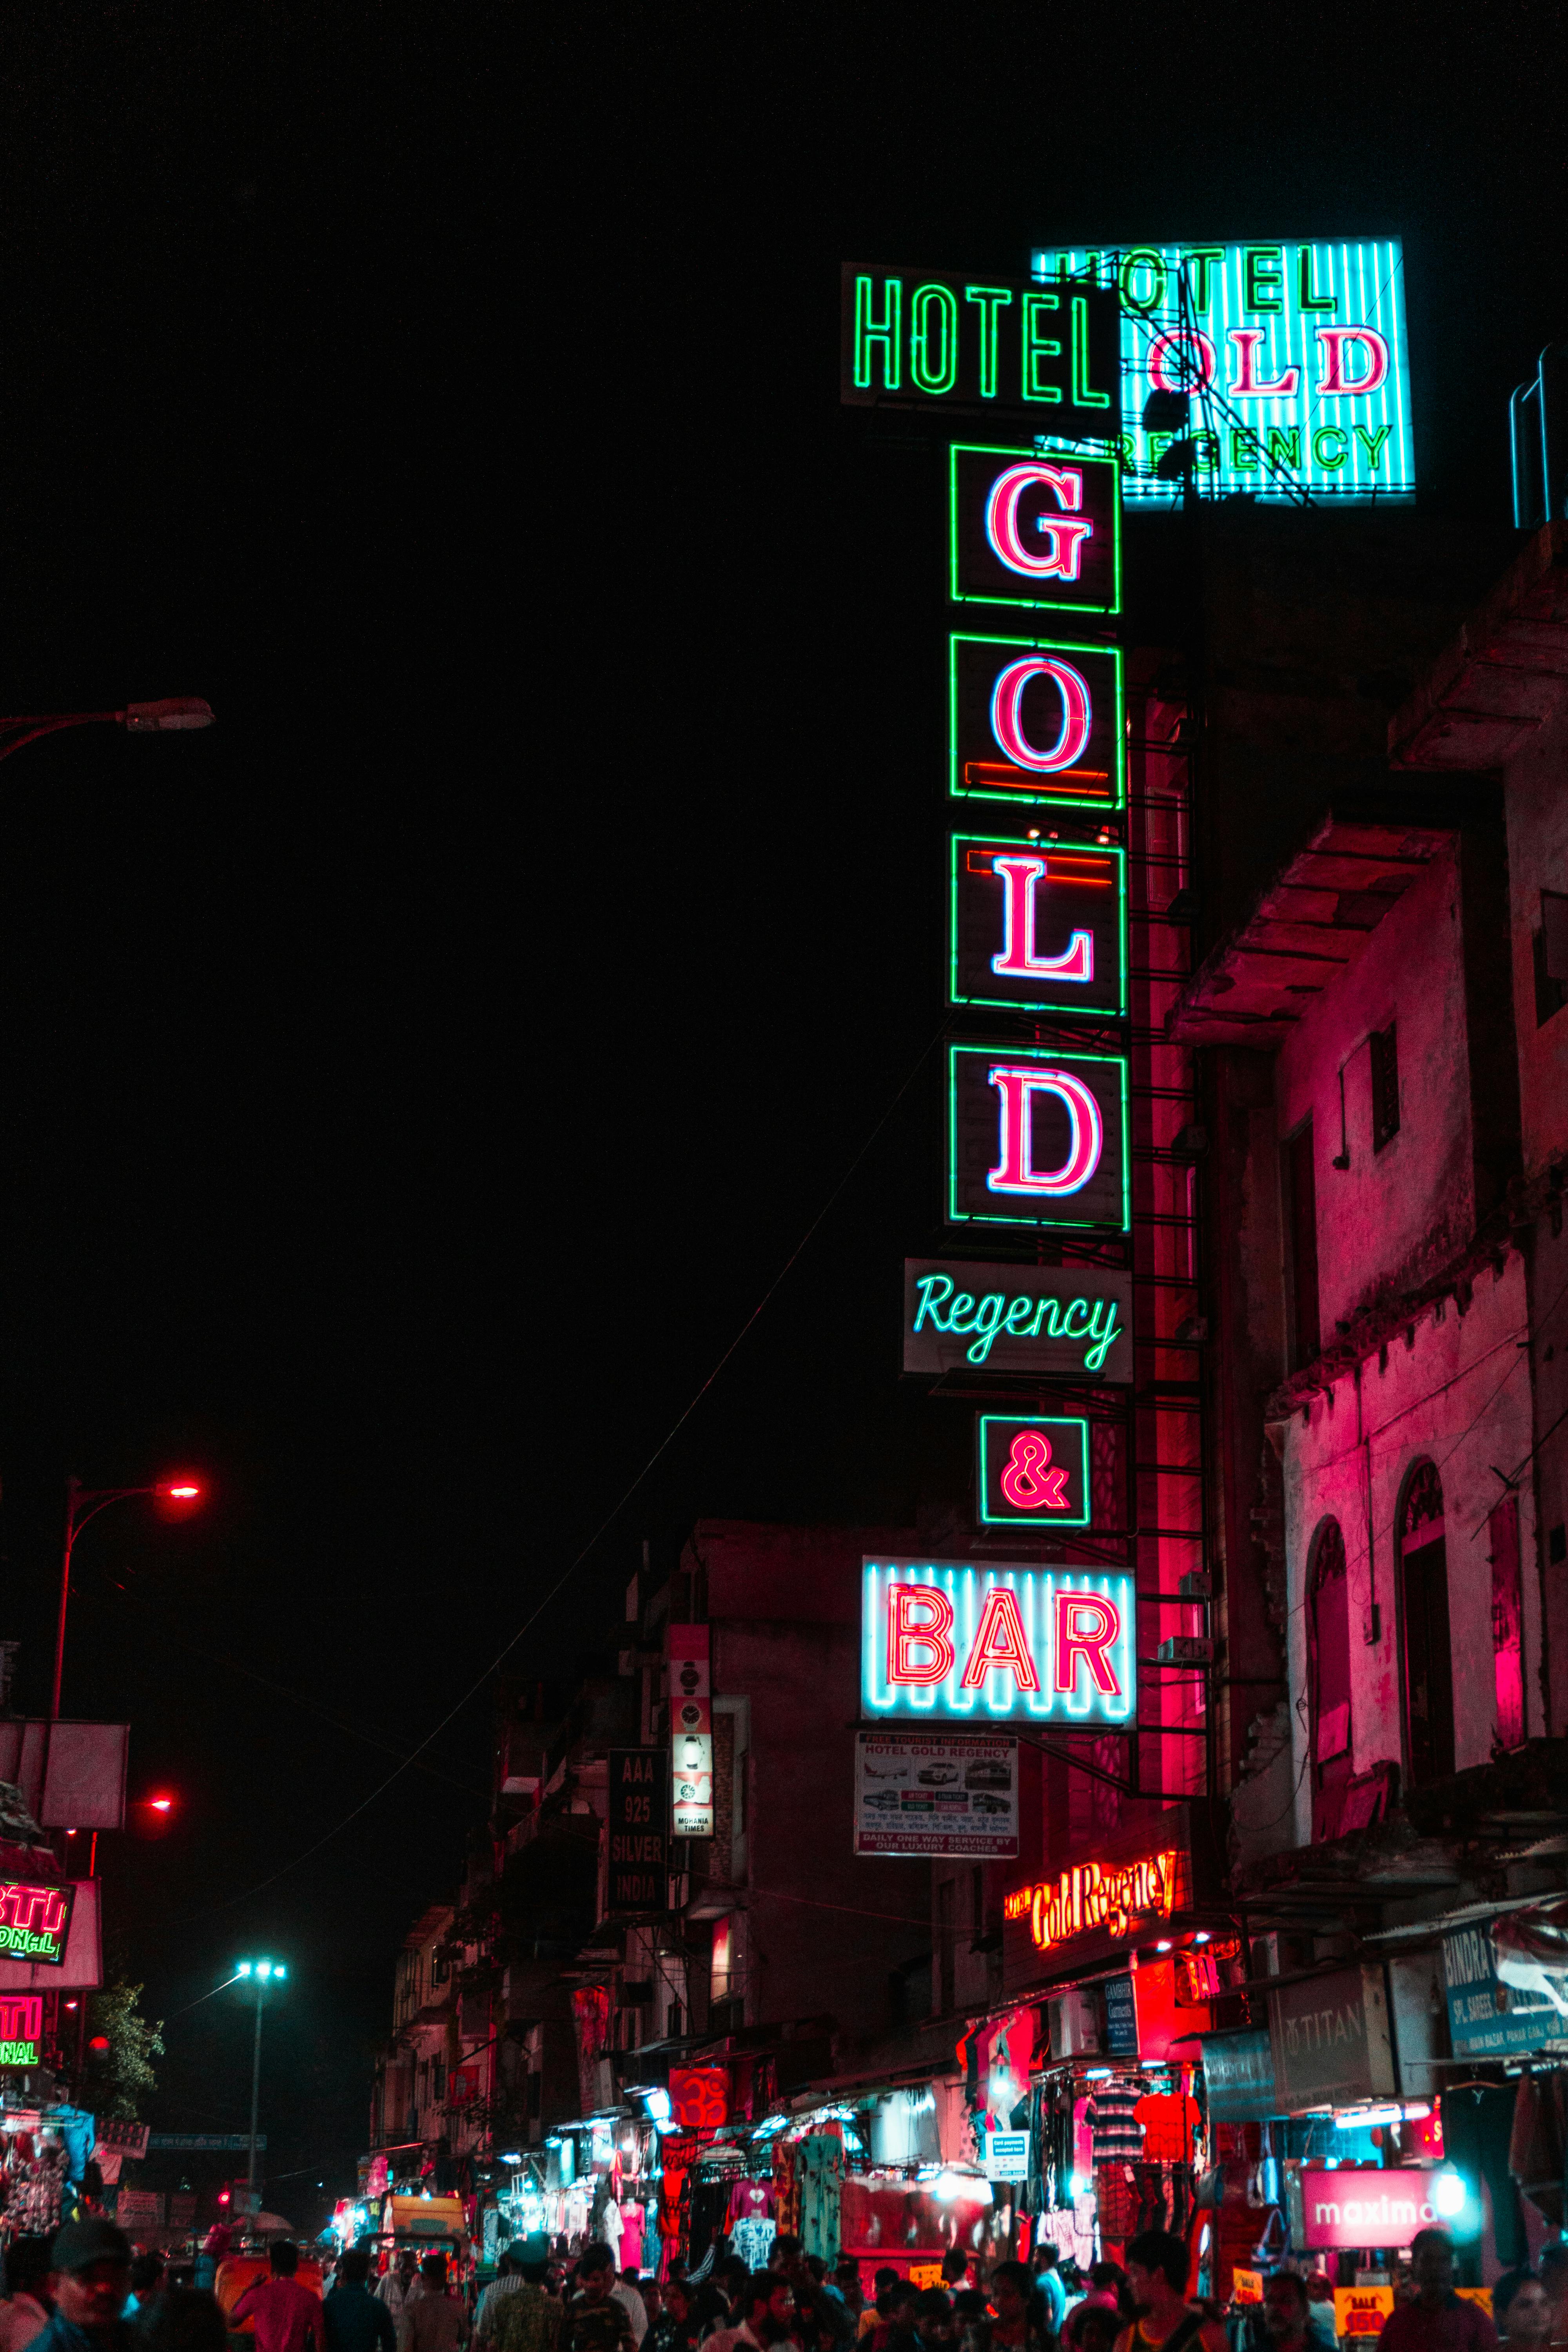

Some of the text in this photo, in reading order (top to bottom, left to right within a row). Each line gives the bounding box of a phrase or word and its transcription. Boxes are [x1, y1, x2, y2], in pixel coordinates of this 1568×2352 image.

[853, 275, 1110, 409] HOTEL
[913, 1271, 1124, 1372] Regency
[1000, 1430, 1071, 1510] &
[887, 1583, 1122, 1696] BAR
[866, 1735, 1010, 1747] FREE TOURIST INFORMATION
[866, 1745, 1010, 1758] HOTEL GOLD REGENCY
[622, 1757, 654, 1783] AAA
[624, 1795, 651, 1823] 925
[612, 1835, 662, 1862] SILVER
[948, 1836, 994, 1844] SERVICE
[948, 1844, 998, 1853] COACHES
[616, 1875, 656, 1902] INDIA
[1300, 2002, 1361, 2051] TITAN
[1351, 2297, 1377, 2310] SALE
[1345, 2311, 1386, 2332] 150
